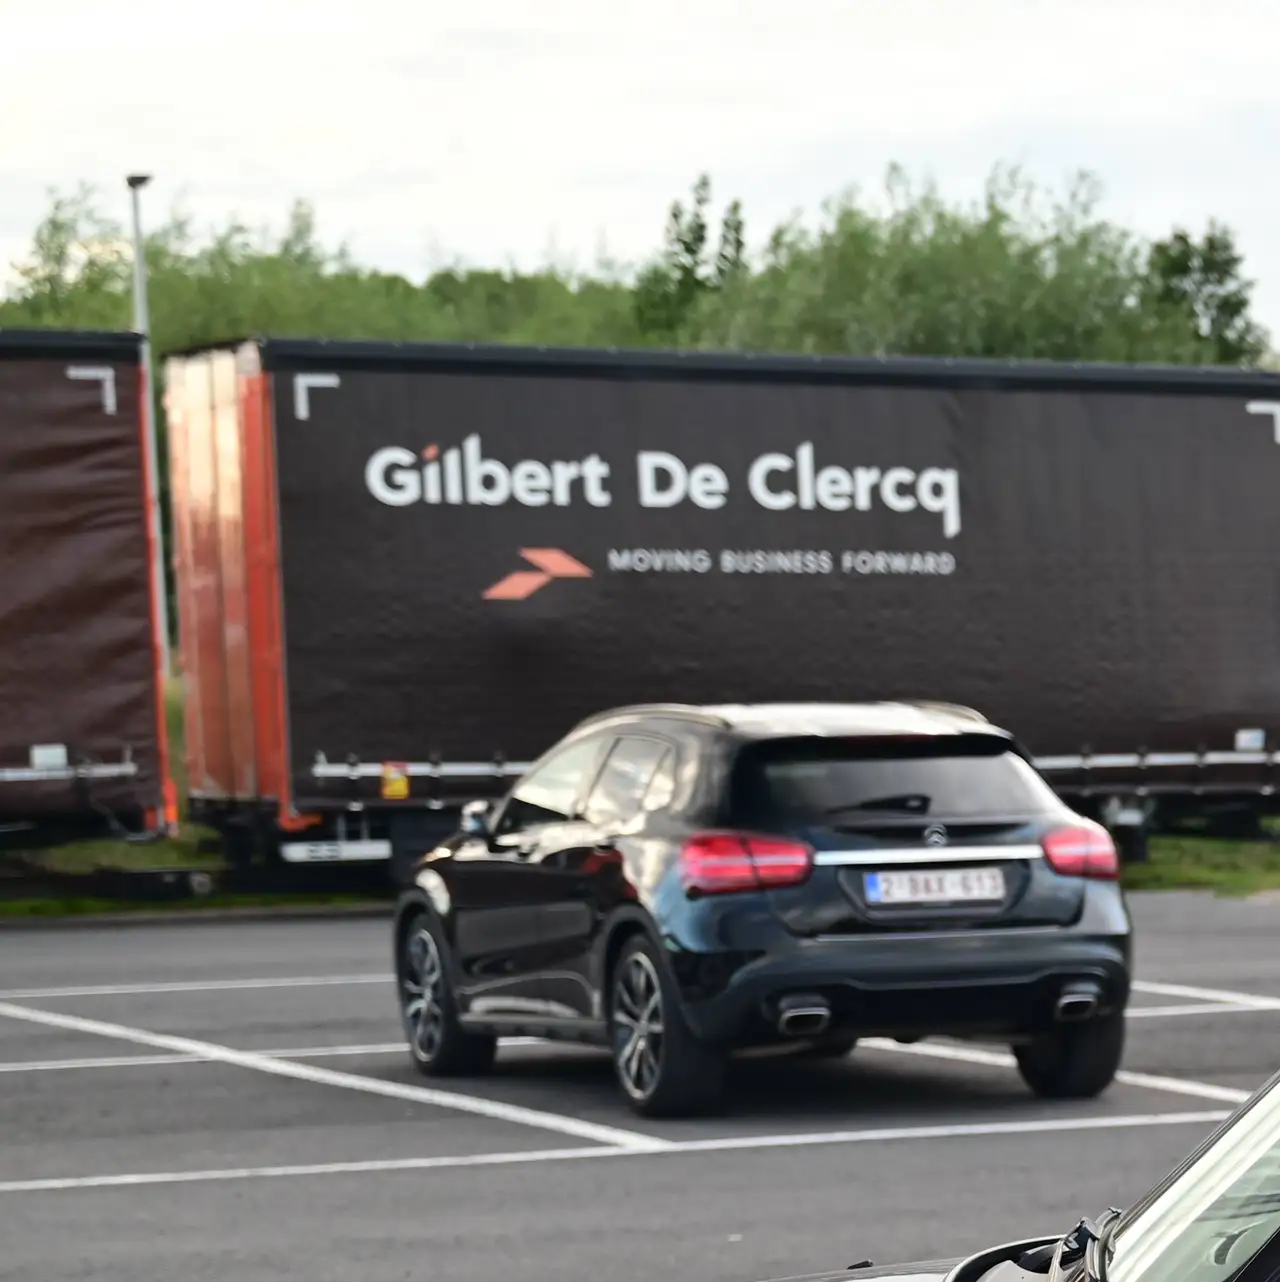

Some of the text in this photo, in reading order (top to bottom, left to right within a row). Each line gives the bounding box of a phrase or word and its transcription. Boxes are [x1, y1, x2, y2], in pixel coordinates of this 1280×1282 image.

[365, 433, 961, 538] Gilbert De Clercq
[608, 549, 956, 576] MOVING BUSINESS FORWARD
